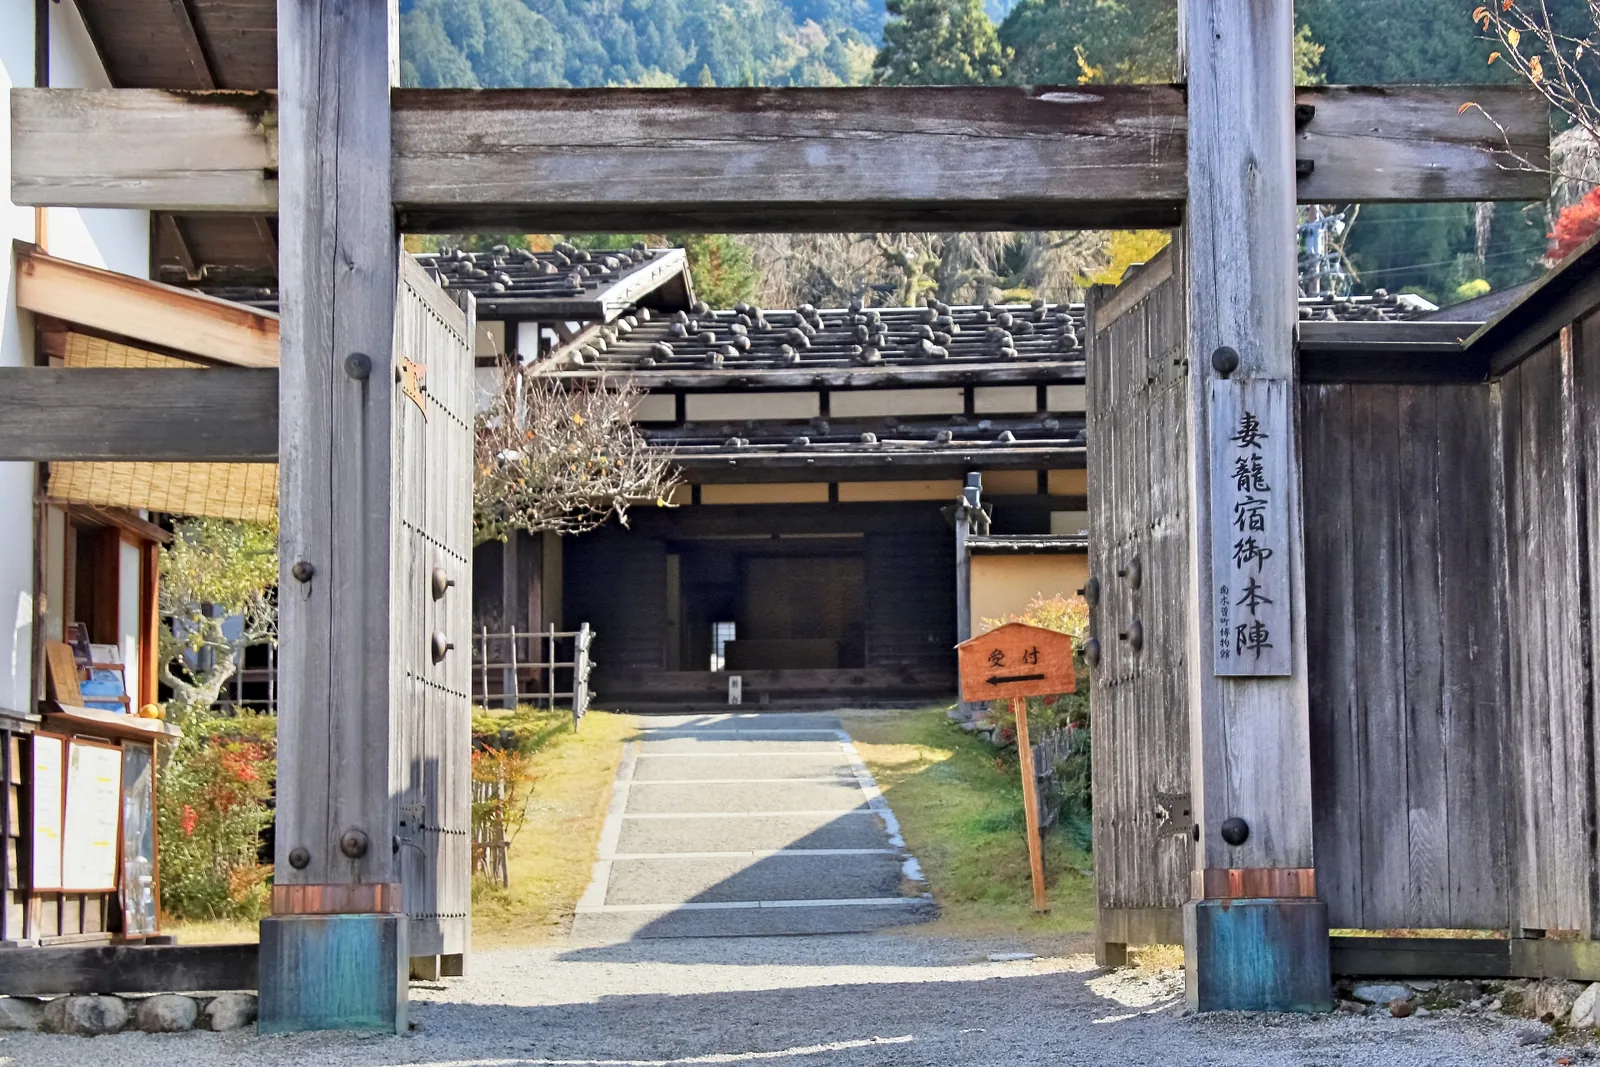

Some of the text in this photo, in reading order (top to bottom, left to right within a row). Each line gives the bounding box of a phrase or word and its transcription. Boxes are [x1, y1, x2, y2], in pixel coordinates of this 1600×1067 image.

[1230, 411, 1273, 660] 妻籠宿御本陣
[988, 646, 1040, 668] 受付
